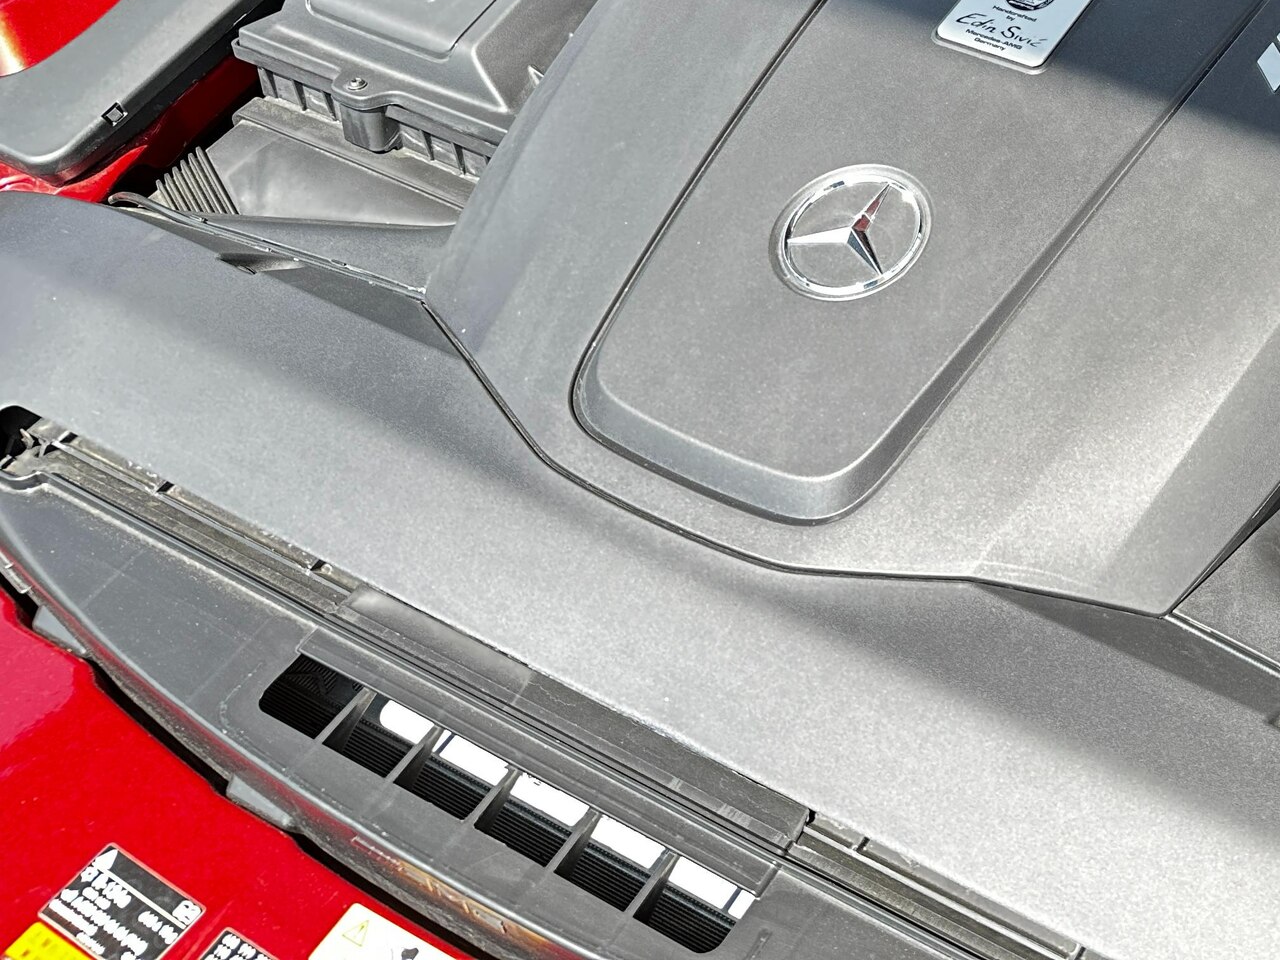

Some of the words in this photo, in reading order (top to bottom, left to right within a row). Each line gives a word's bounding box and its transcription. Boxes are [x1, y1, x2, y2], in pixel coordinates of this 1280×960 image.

[992, 5, 1037, 22] Handcrafted
[1006, 14, 1016, 22] by
[956, 12, 997, 34] Edin
[965, 28, 1023, 50] Mercedes-AMG
[974, 37, 1006, 51] Germany
